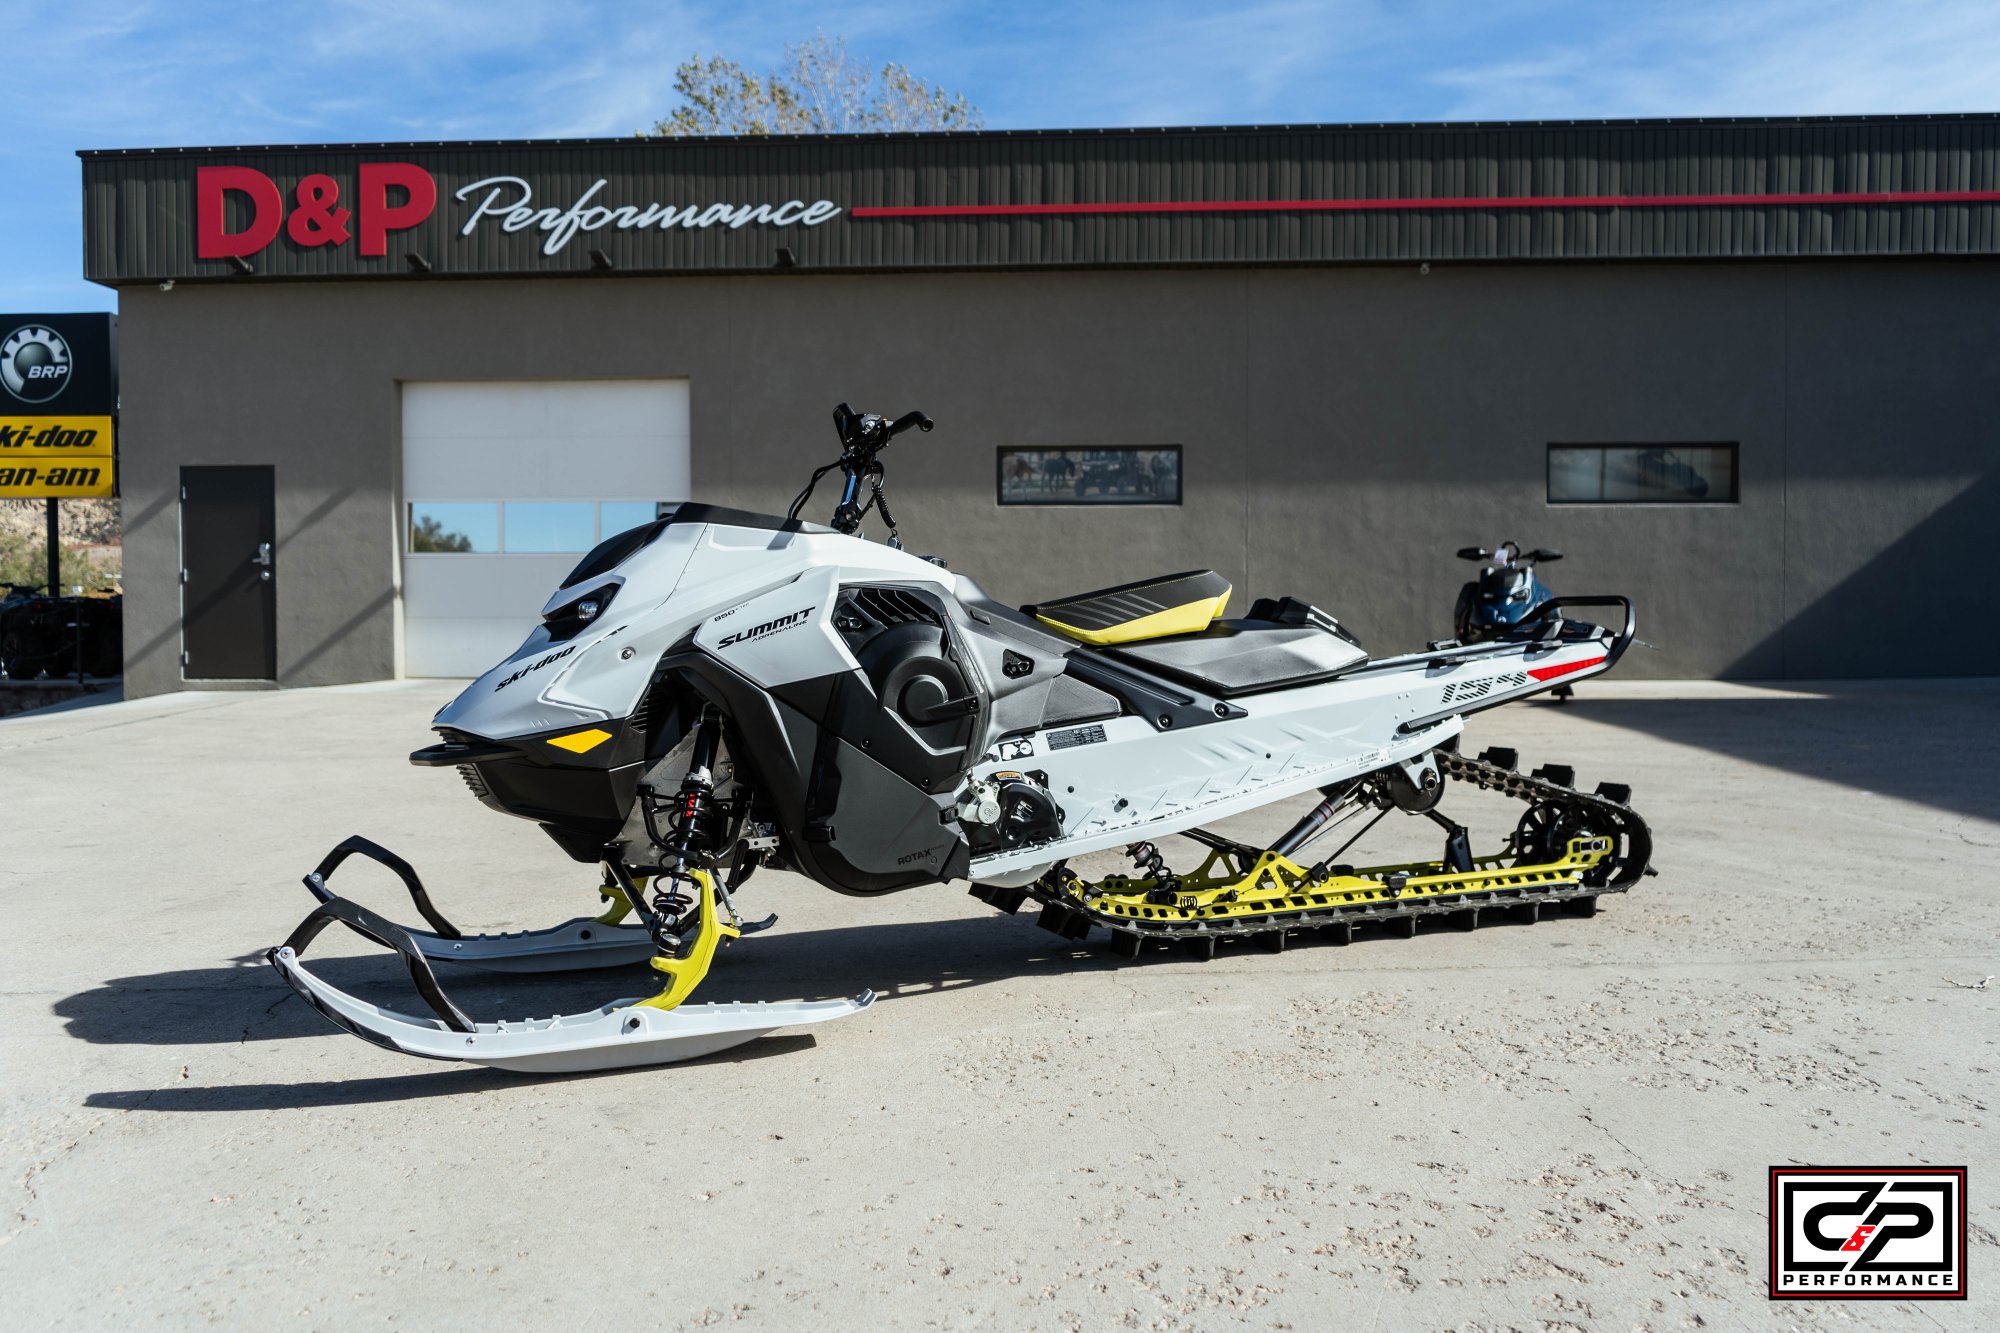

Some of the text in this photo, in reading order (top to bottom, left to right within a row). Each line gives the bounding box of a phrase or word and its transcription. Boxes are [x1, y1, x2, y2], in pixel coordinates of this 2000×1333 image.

[196, 162, 843, 260] D&P Performance
[27, 365, 68, 379] BRP
[714, 609, 736, 622] 850
[717, 606, 816, 650] SUMMIT
[751, 620, 808, 642] ADRENALINE
[1440, 671, 1528, 704] 154
[897, 848, 932, 866] ROTAX
